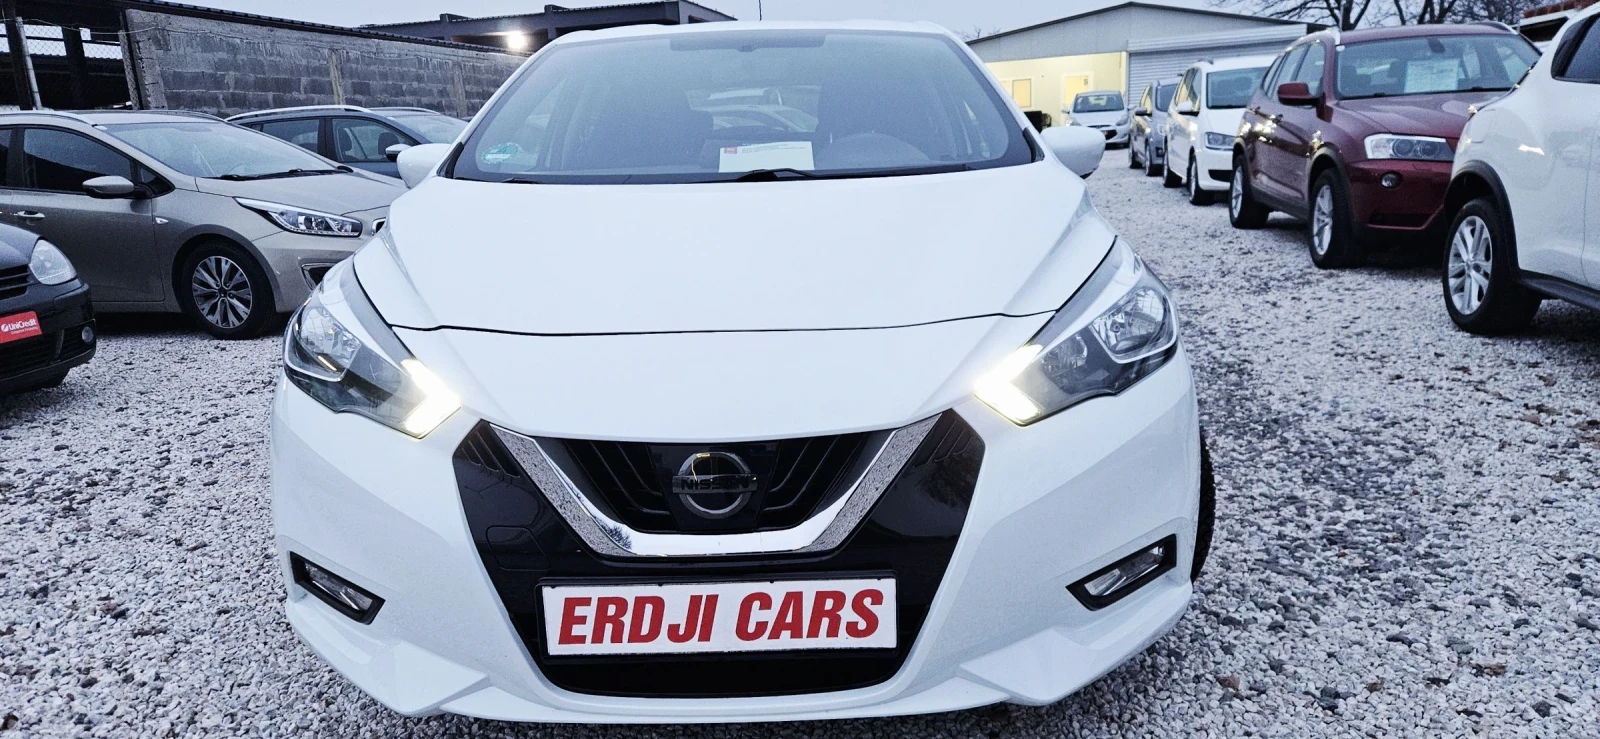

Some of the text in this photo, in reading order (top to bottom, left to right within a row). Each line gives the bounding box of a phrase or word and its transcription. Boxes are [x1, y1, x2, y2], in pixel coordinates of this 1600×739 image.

[8, 318, 37, 330] UniCredit
[558, 589, 884, 645] ERDJI CARS
